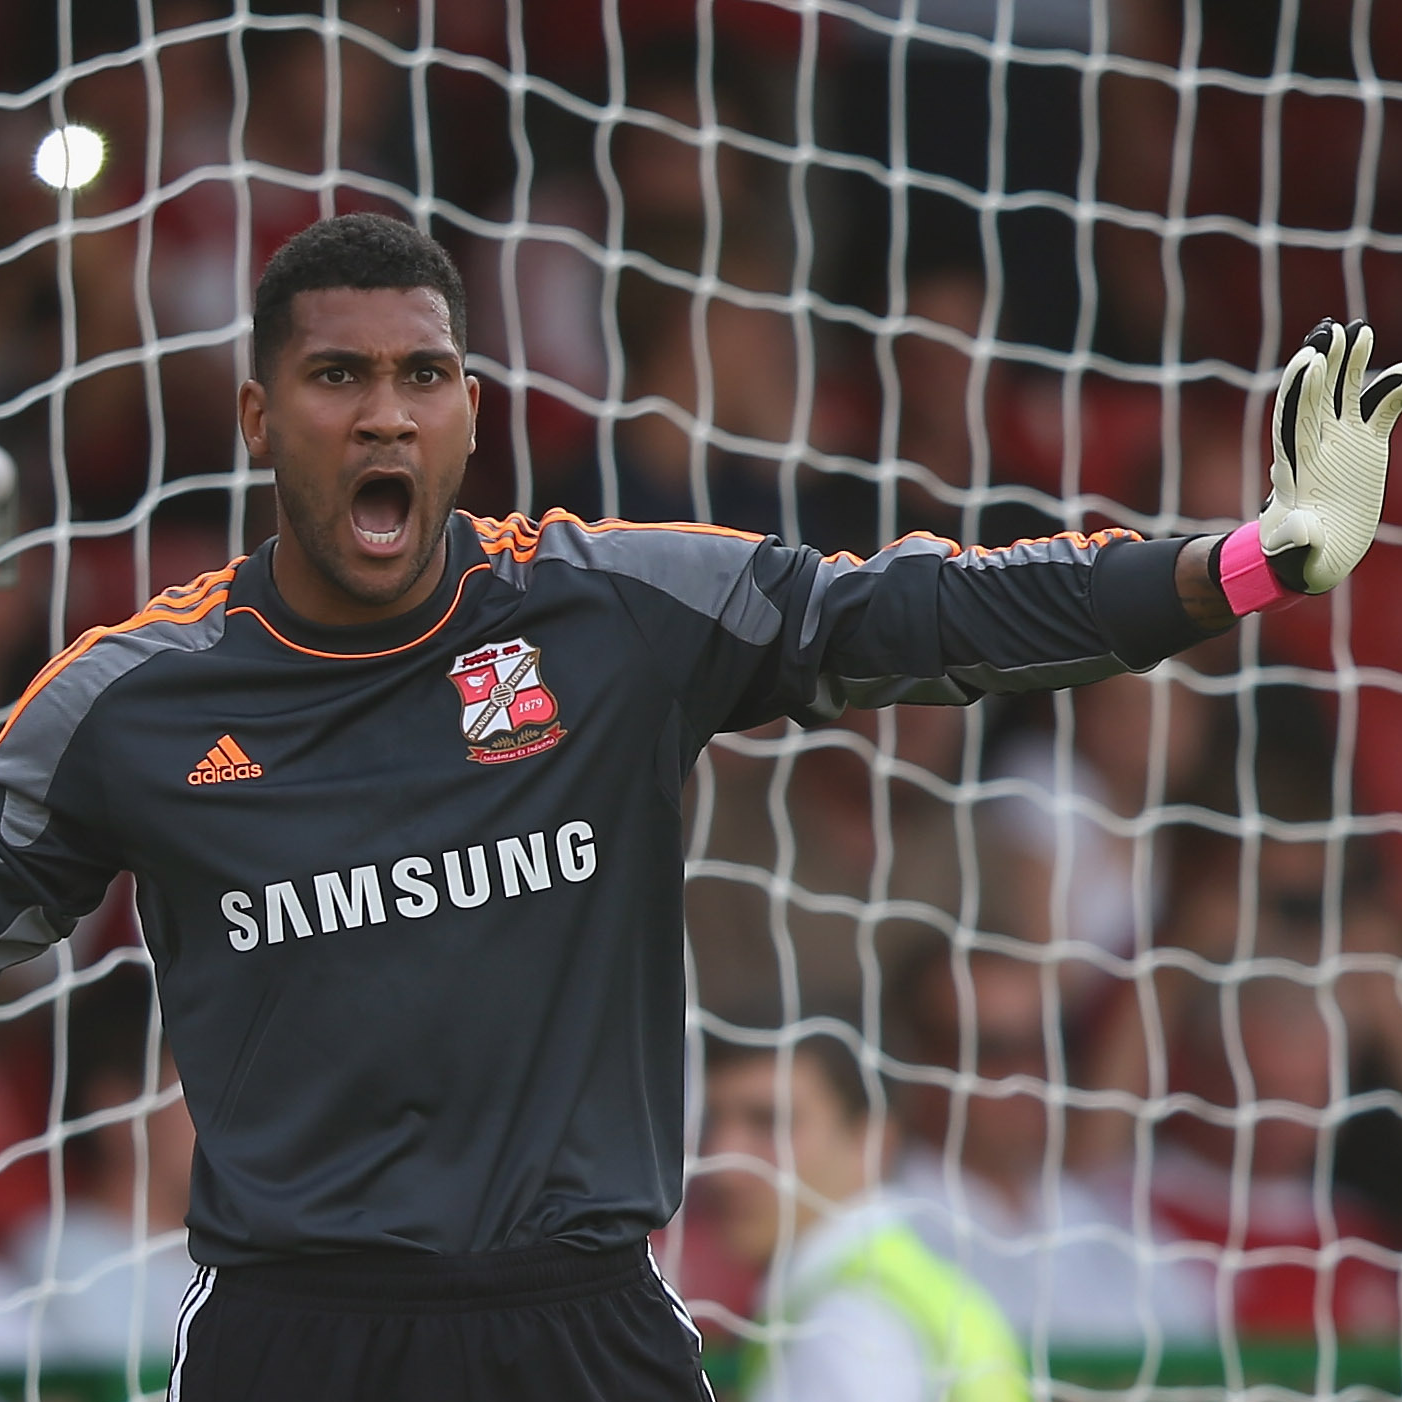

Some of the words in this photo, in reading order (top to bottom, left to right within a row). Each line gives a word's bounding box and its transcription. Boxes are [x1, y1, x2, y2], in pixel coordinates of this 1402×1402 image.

[518, 698, 543, 713] 1879
[468, 703, 497, 740] SWINDON
[187, 763, 263, 785] adidas
[220, 820, 597, 952] SAMSUNG
